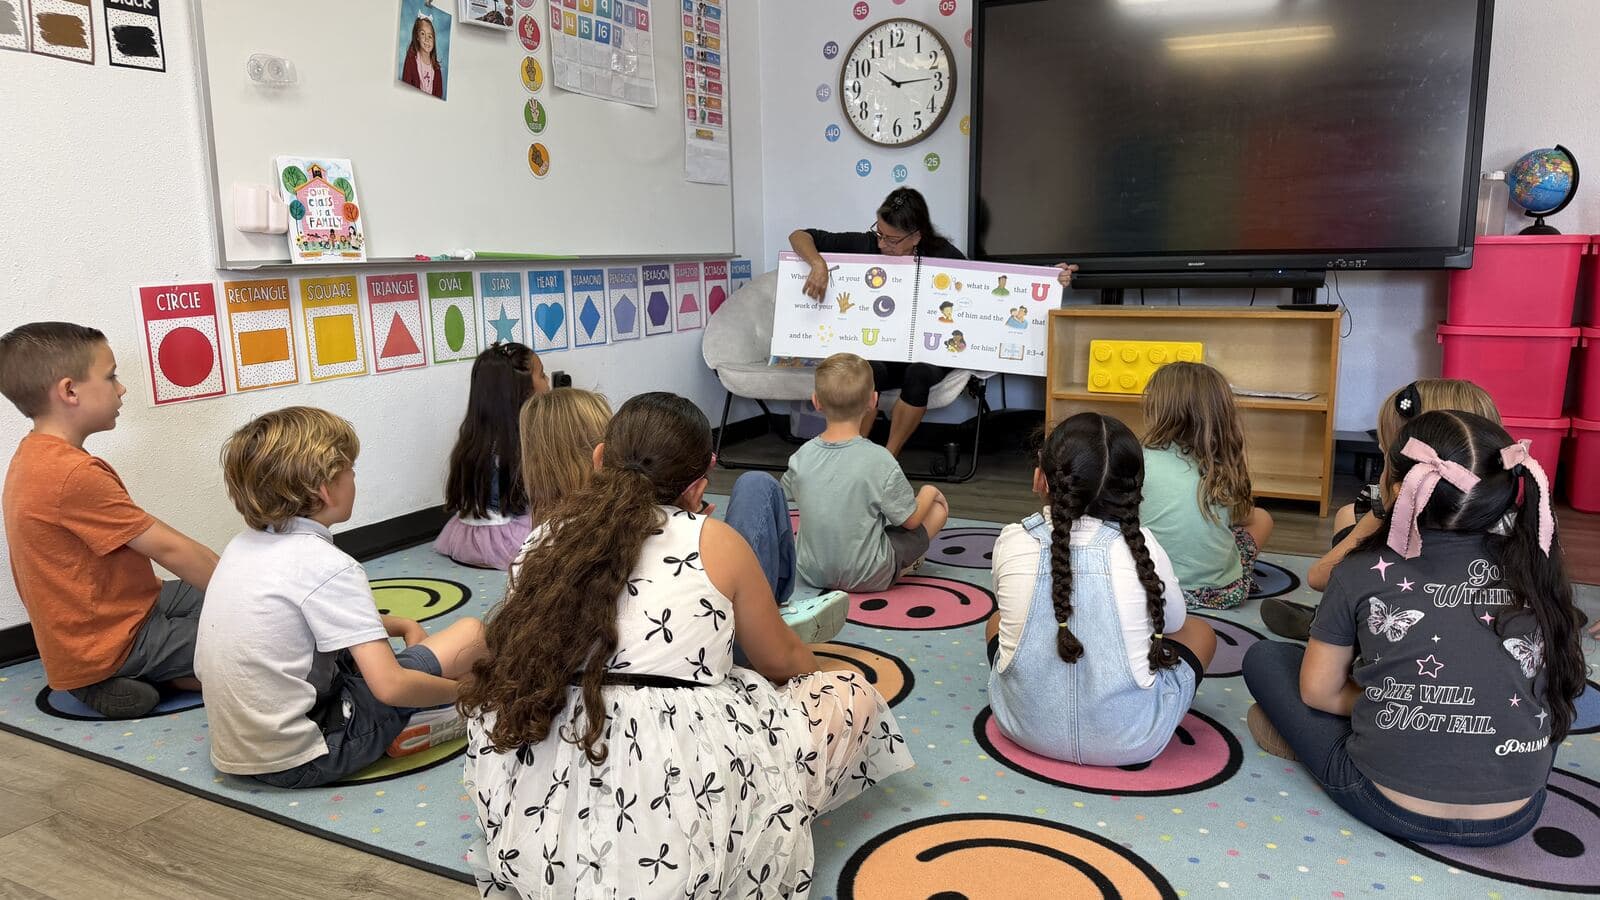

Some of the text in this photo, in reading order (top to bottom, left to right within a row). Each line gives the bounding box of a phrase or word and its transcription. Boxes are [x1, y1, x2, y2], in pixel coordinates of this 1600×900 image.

[110, 0, 153, 10] ack
[553, 9, 560, 25] 13
[565, 15, 574, 30] 14
[581, 19, 590, 34] 15
[598, 23, 608, 39] 16
[638, 12, 647, 26] 12
[889, 28, 905, 48] 12
[915, 34, 922, 53] 1
[870, 39, 885, 59] 11
[855, 59, 871, 78] 10
[929, 50, 939, 70] 2
[852, 81, 861, 100] 9
[933, 71, 943, 91] 3
[859, 101, 869, 120] 8
[926, 95, 937, 113] 4
[875, 114, 883, 132] 7
[892, 118, 902, 137] 6
[913, 111, 922, 130] 5
[309, 217, 343, 228] FAMILY
[643, 269, 669, 281] HEXAGON
[704, 264, 727, 276] OCTAGON
[845, 275, 860, 283] your
[370, 280, 415, 297] TRIANGLE
[438, 278, 463, 292] OVAL
[491, 277, 511, 291] STAR
[536, 275, 558, 289] HEART
[572, 274, 601, 287] DIAMOND
[156, 291, 201, 311] CIRCLE
[228, 285, 288, 304] RECTANGLE
[306, 282, 352, 301] SQUARE
[966, 282, 983, 291] what
[1013, 286, 1027, 294] that
[1031, 282, 1051, 302] U
[818, 303, 833, 311] your
[858, 304, 870, 312] the
[965, 312, 978, 320] him
[979, 313, 992, 321] and
[992, 314, 1004, 322] the
[1031, 318, 1046, 326] that
[839, 334, 859, 342] which
[862, 327, 880, 347] U
[923, 332, 942, 351] U
[980, 344, 998, 352] him?
[1468, 558, 1508, 587] GO
